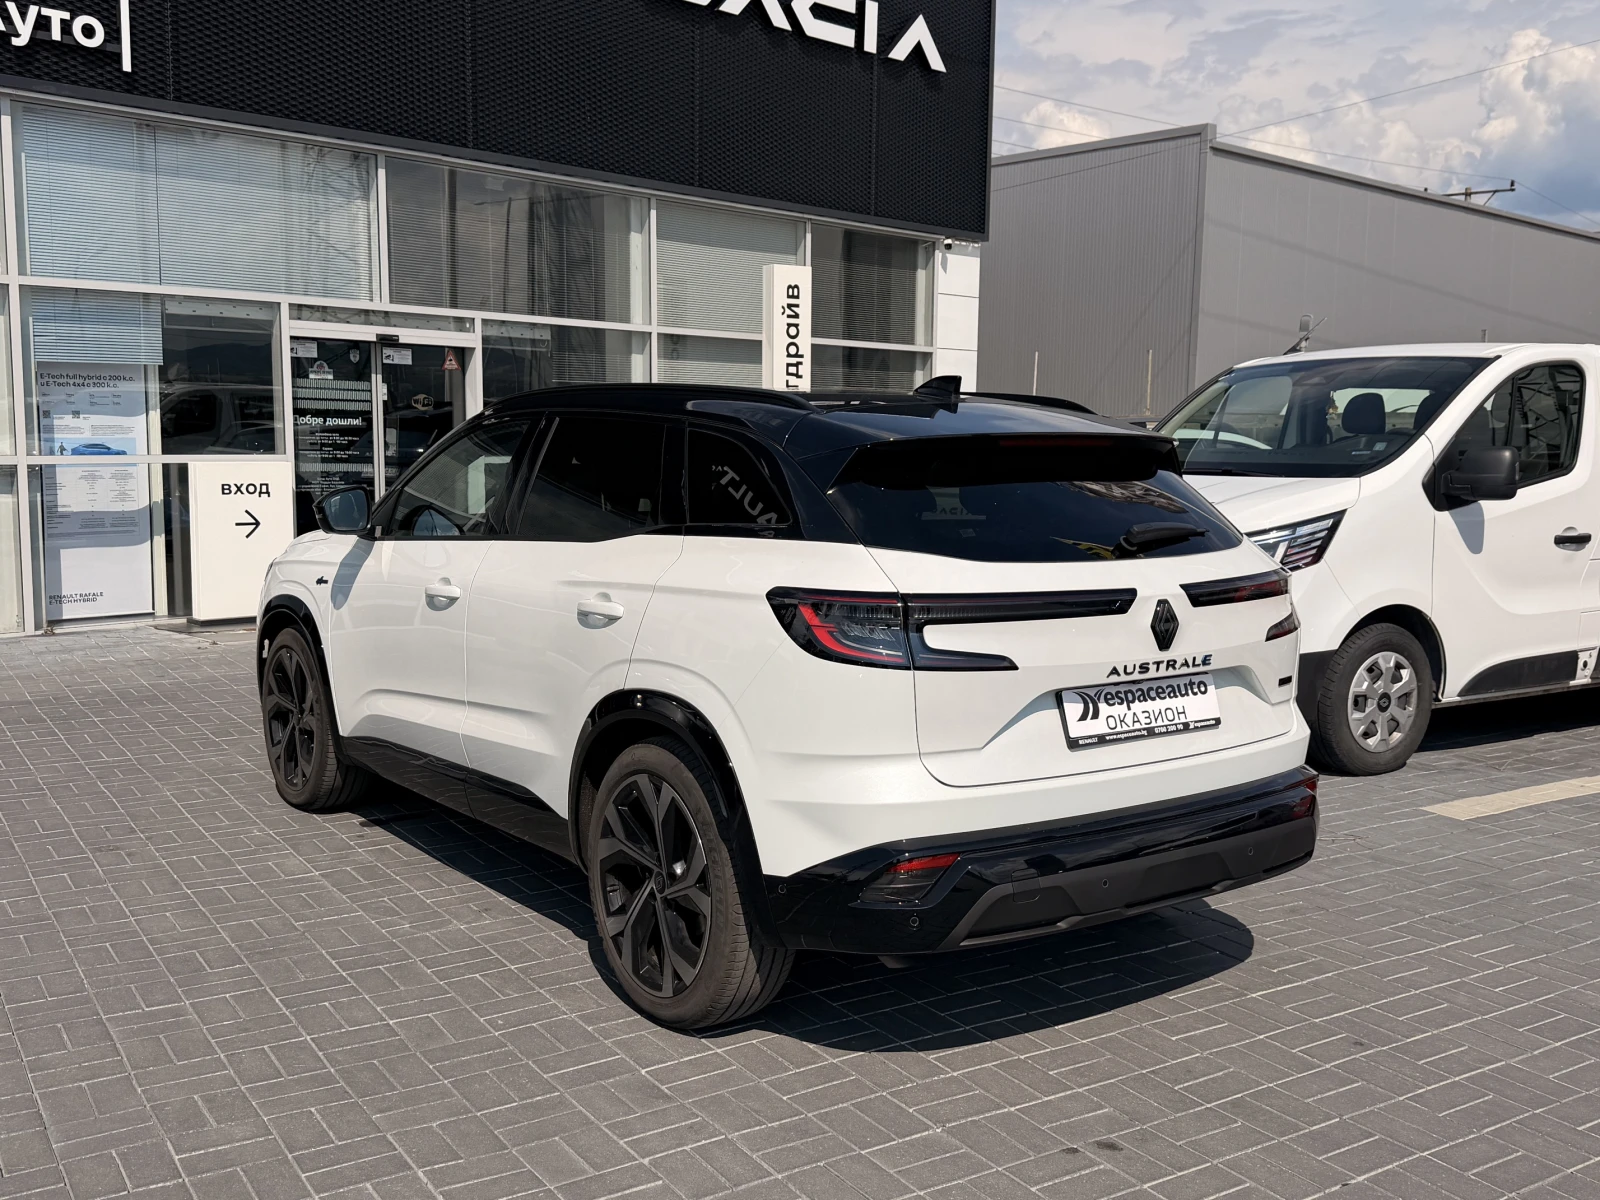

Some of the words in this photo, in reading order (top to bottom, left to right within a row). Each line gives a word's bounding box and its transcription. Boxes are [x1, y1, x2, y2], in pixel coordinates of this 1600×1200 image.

[0, 1, 105, 47] уто
[78, 374, 102, 382] hybrid
[326, 416, 362, 426] дошли!
[1106, 653, 1213, 678] AUSTRALE
[1103, 677, 1209, 710] espaceauto
[1105, 705, 1188, 730] ОКАЗИОН
